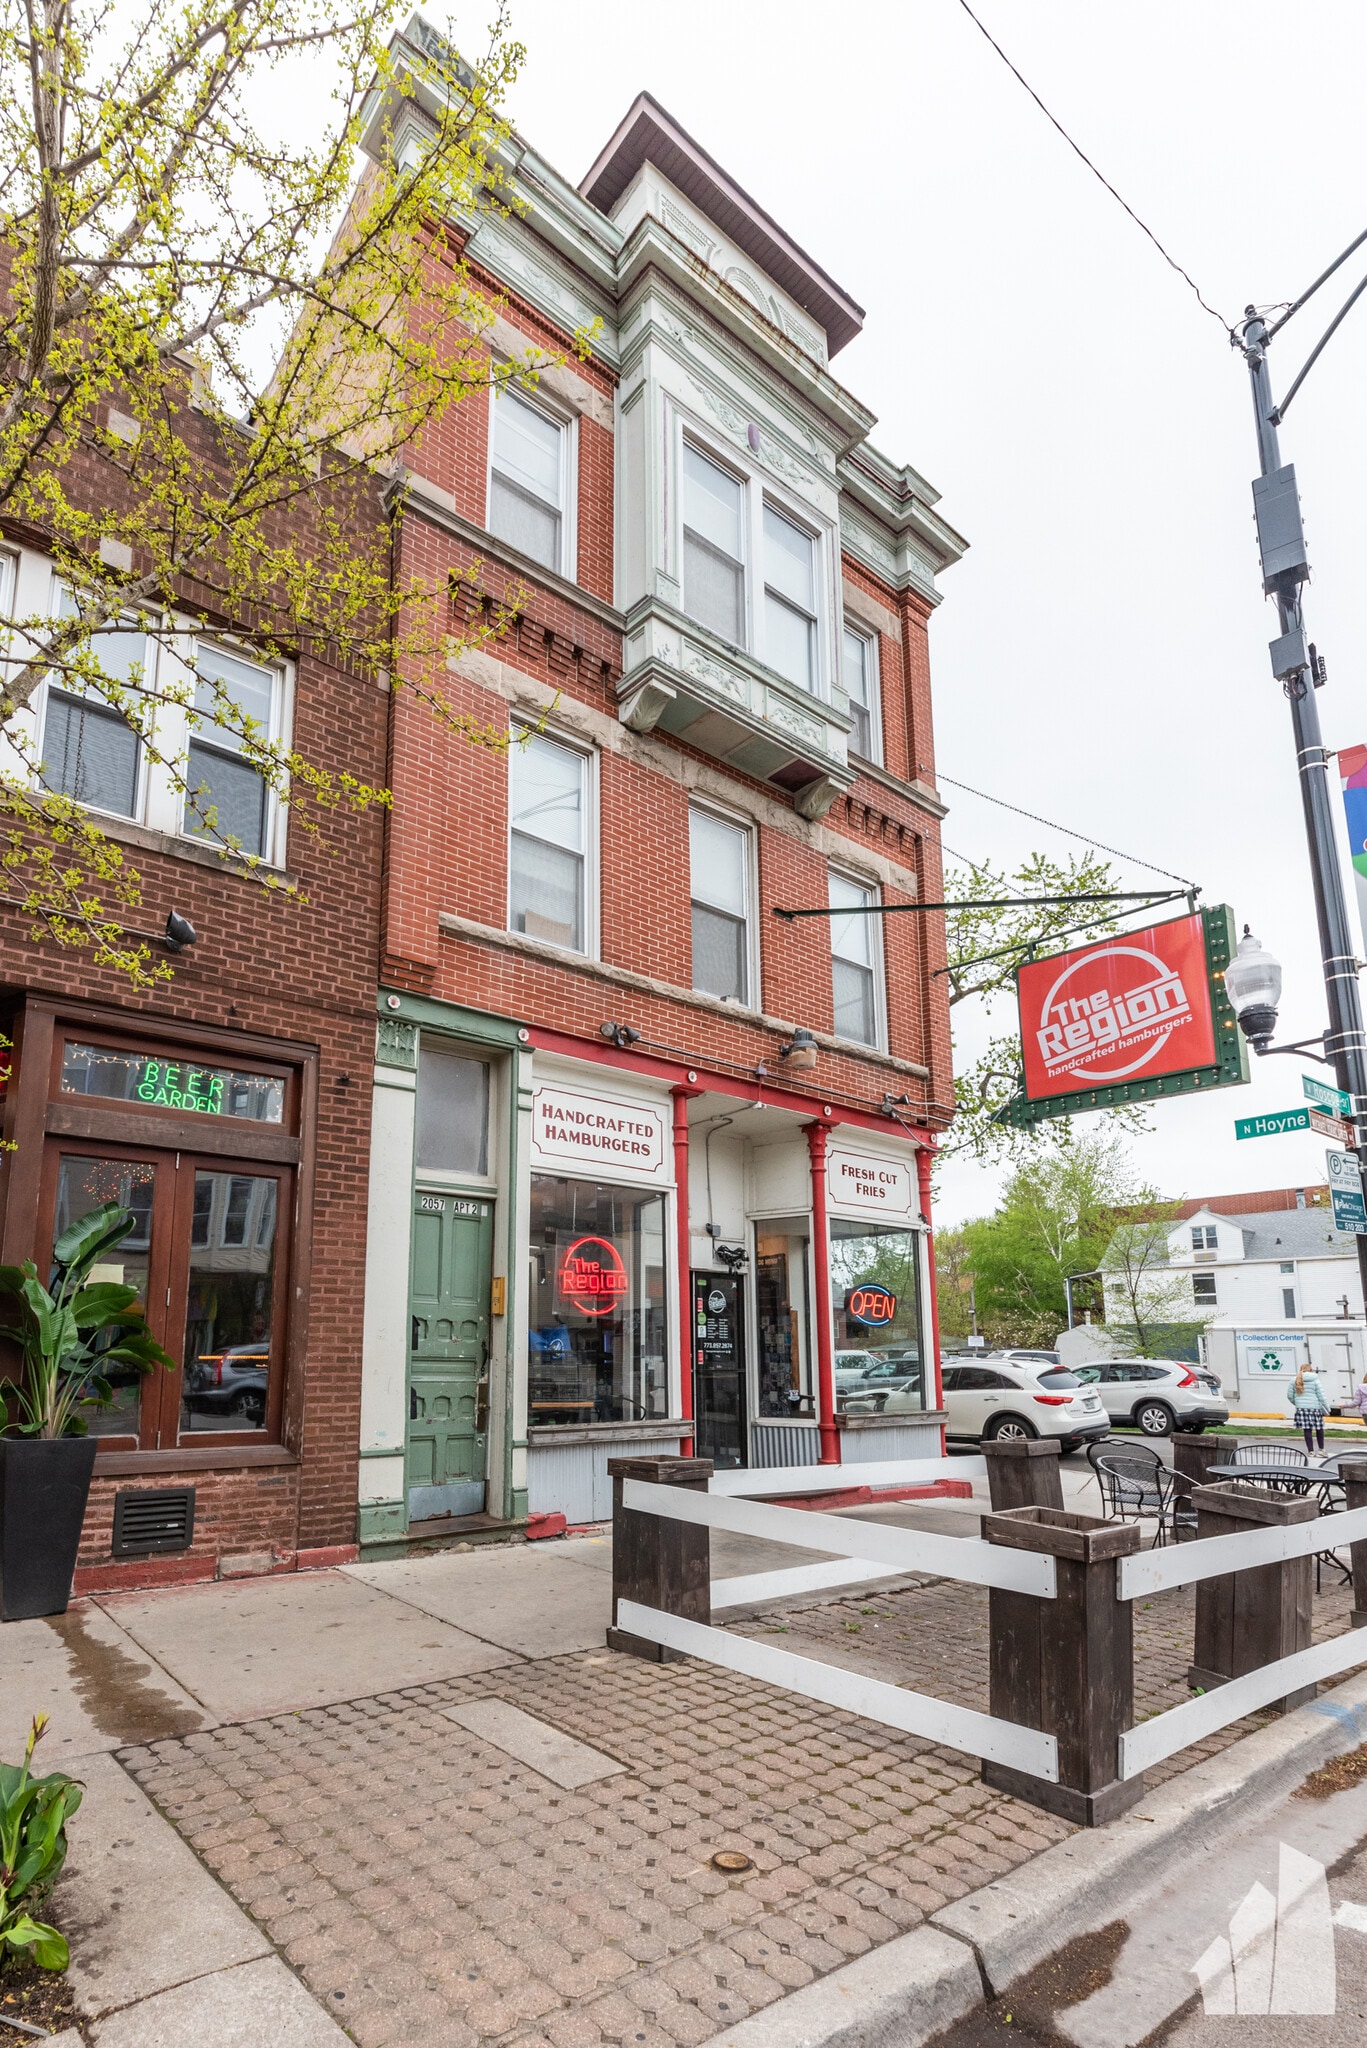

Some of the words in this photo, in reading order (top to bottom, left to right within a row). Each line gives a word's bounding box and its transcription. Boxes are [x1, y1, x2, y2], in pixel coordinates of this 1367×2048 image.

[1036, 978, 1188, 1061] Region
[1051, 988, 1110, 1026] The
[1047, 1043, 1116, 1078] handcrafted
[1118, 1013, 1193, 1050] hamburgers
[144, 1062, 224, 1099] BEER
[138, 1083, 221, 1115] GARDEN
[542, 1103, 654, 1138] HANDCRAFTED
[1244, 1124, 1251, 1134] N
[1255, 1114, 1306, 1133] Hoyne
[545, 1124, 651, 1156] HAMBURGERS
[841, 1164, 875, 1181] FRESH
[879, 1171, 898, 1185] CUT
[856, 1182, 886, 1198] FRIES
[422, 1197, 445, 1210] 2057
[454, 1201, 470, 1214] APT
[571, 1257, 600, 1273] The
[562, 1269, 629, 1294] Region
[850, 1290, 896, 1319] OPEN
